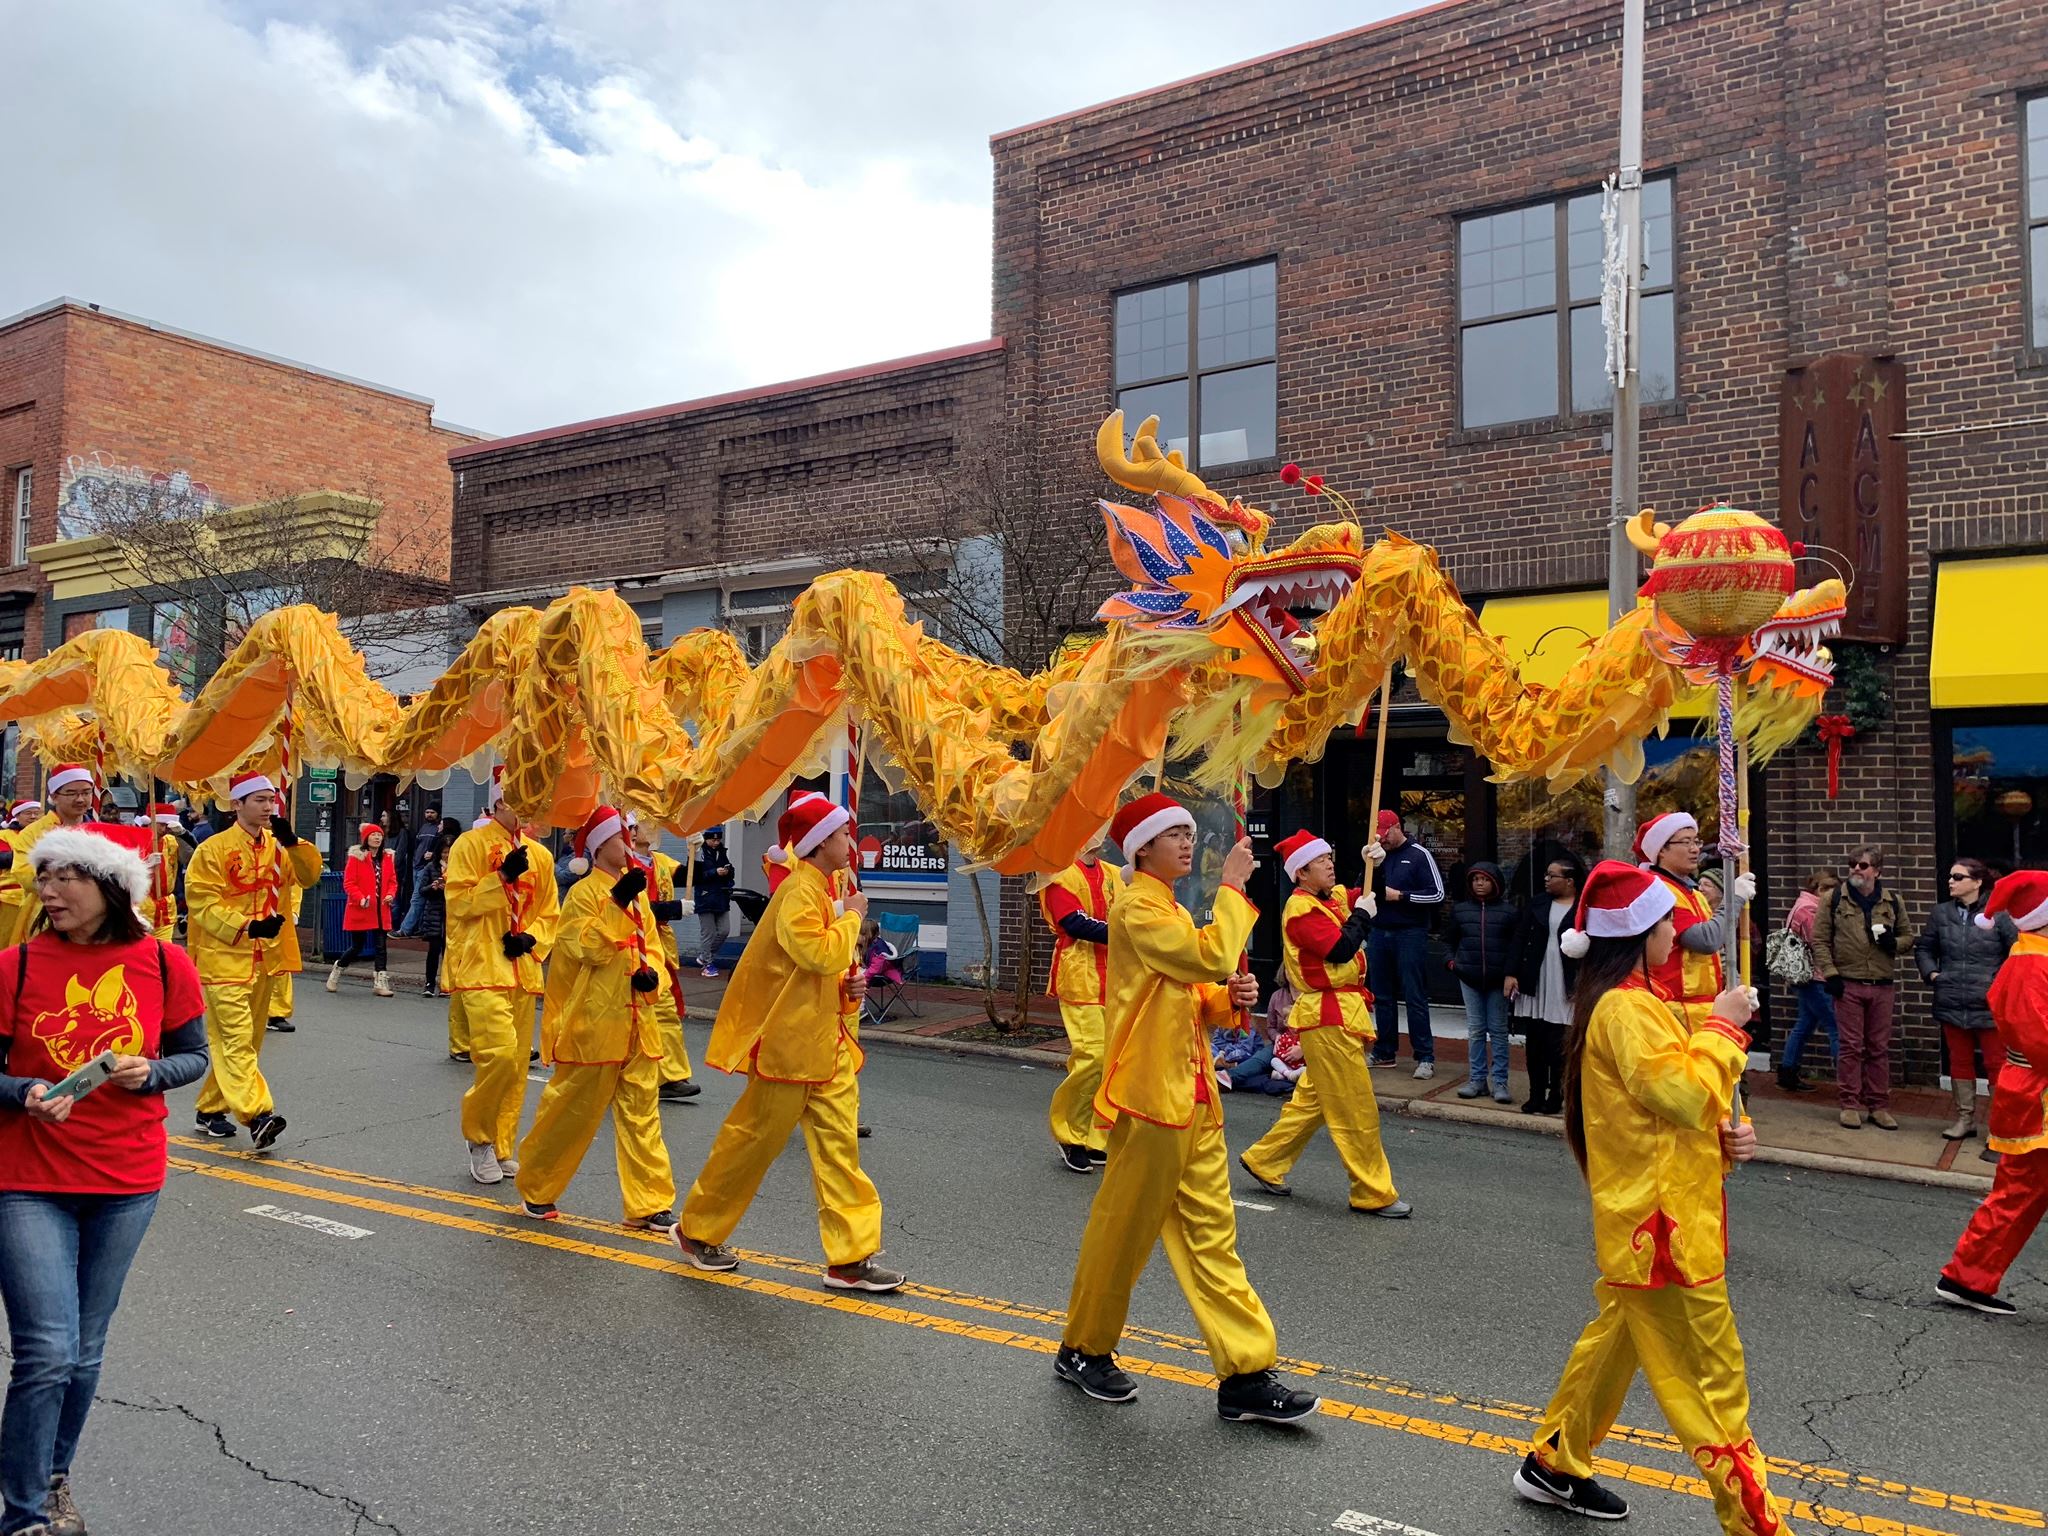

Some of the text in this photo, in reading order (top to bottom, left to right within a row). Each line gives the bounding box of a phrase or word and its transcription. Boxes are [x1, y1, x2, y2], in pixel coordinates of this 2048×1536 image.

[1798, 419, 1823, 578] ACM
[1853, 409, 1884, 630] ACME
[882, 857, 945, 869] BUILDERS
[883, 845, 924, 856] SPACE
